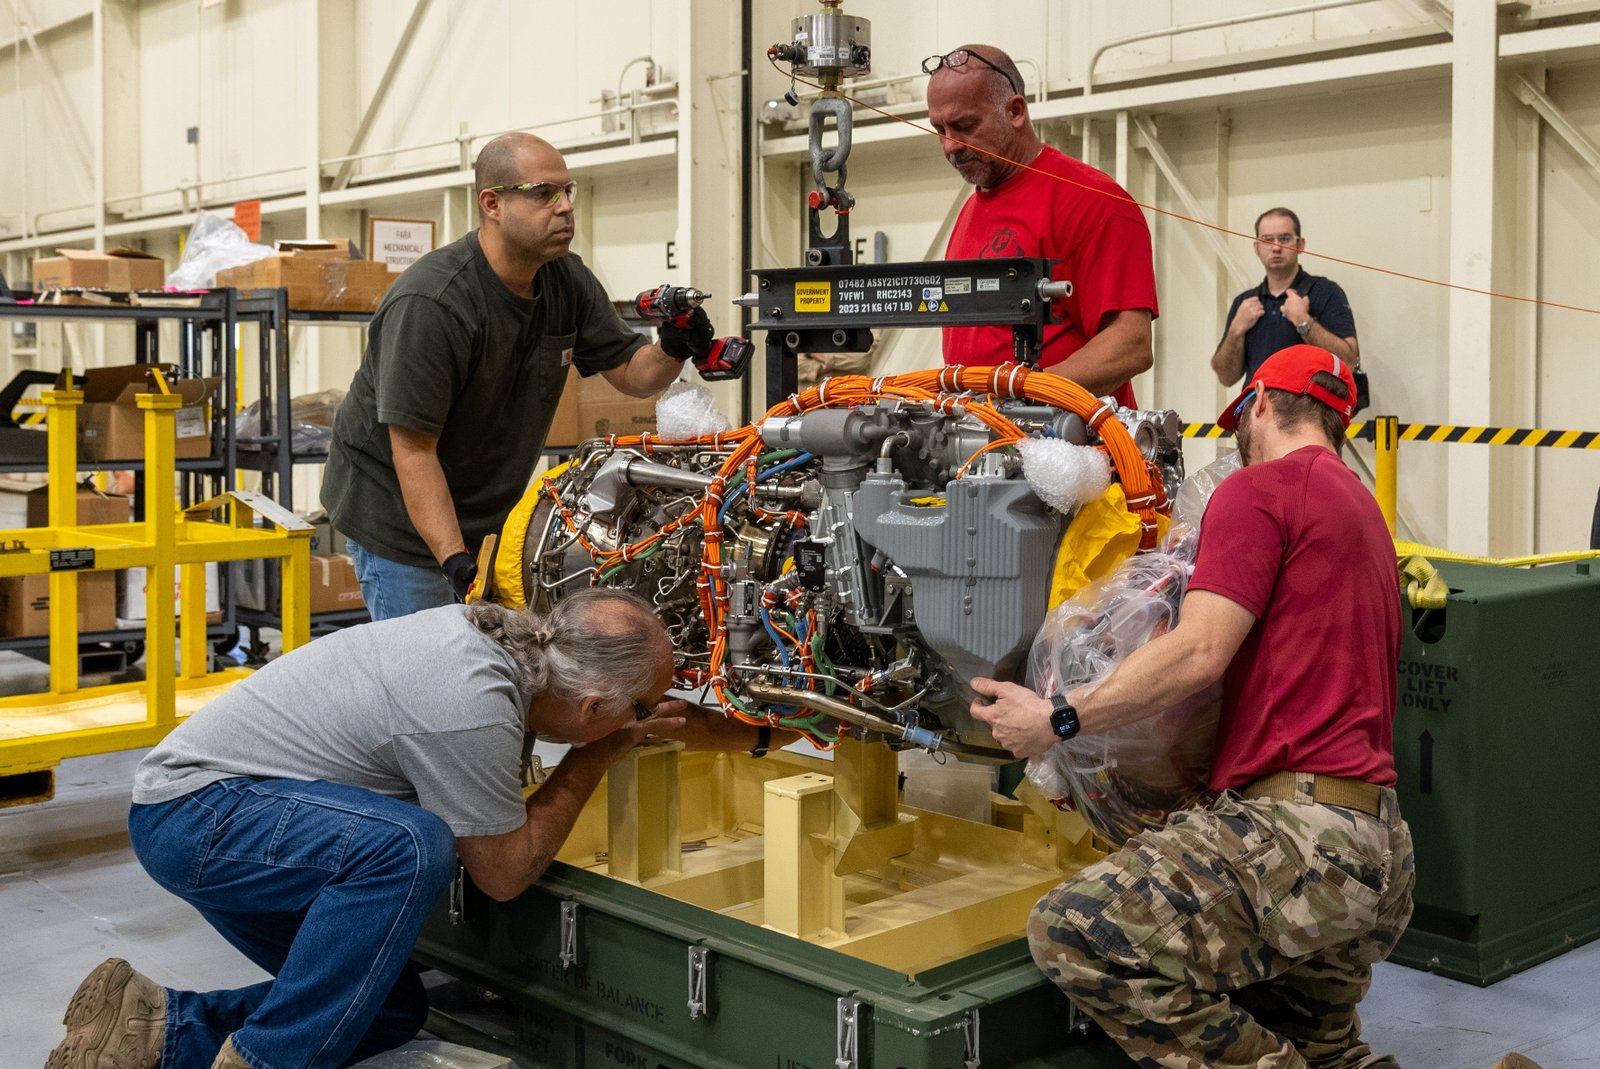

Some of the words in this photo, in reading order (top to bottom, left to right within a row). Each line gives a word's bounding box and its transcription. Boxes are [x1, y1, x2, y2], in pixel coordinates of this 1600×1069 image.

[838, 279, 865, 289] 07482
[796, 288, 829, 296] GOVERNMENT
[838, 291, 865, 301] 7VFW1
[876, 289, 912, 300] RHC2143
[838, 304, 860, 314] 2023
[861, 303, 870, 313] 21
[871, 303, 882, 312] KG
[884, 302, 898, 312] (47
[900, 301, 913, 312] LB)
[1397, 659, 1459, 681] COVER
[1407, 677, 1447, 695] LIFT
[1402, 692, 1452, 713] ONLY
[596, 980, 665, 1024] BALANCE
